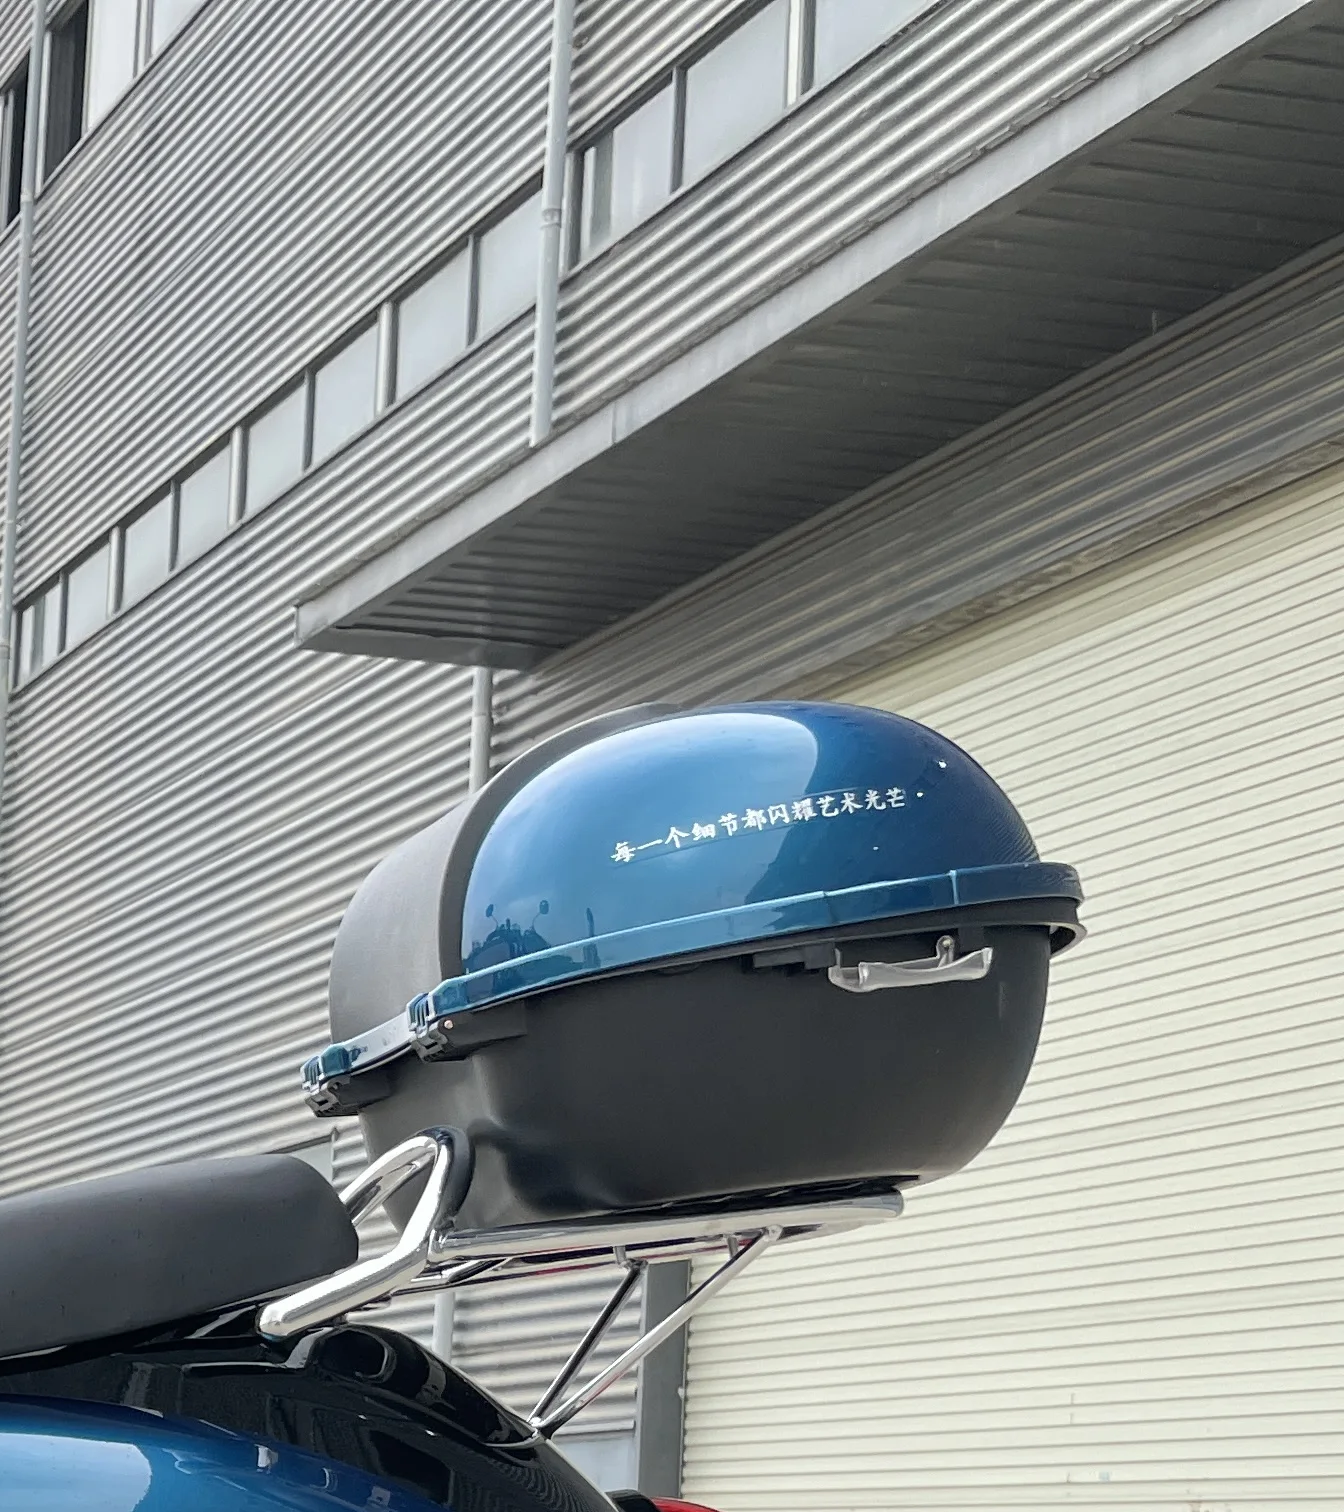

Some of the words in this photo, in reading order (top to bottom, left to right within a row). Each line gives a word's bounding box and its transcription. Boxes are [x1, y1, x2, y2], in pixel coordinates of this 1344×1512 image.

[611, 787, 906, 863] 每一个细节都闪耀艺术光芒
